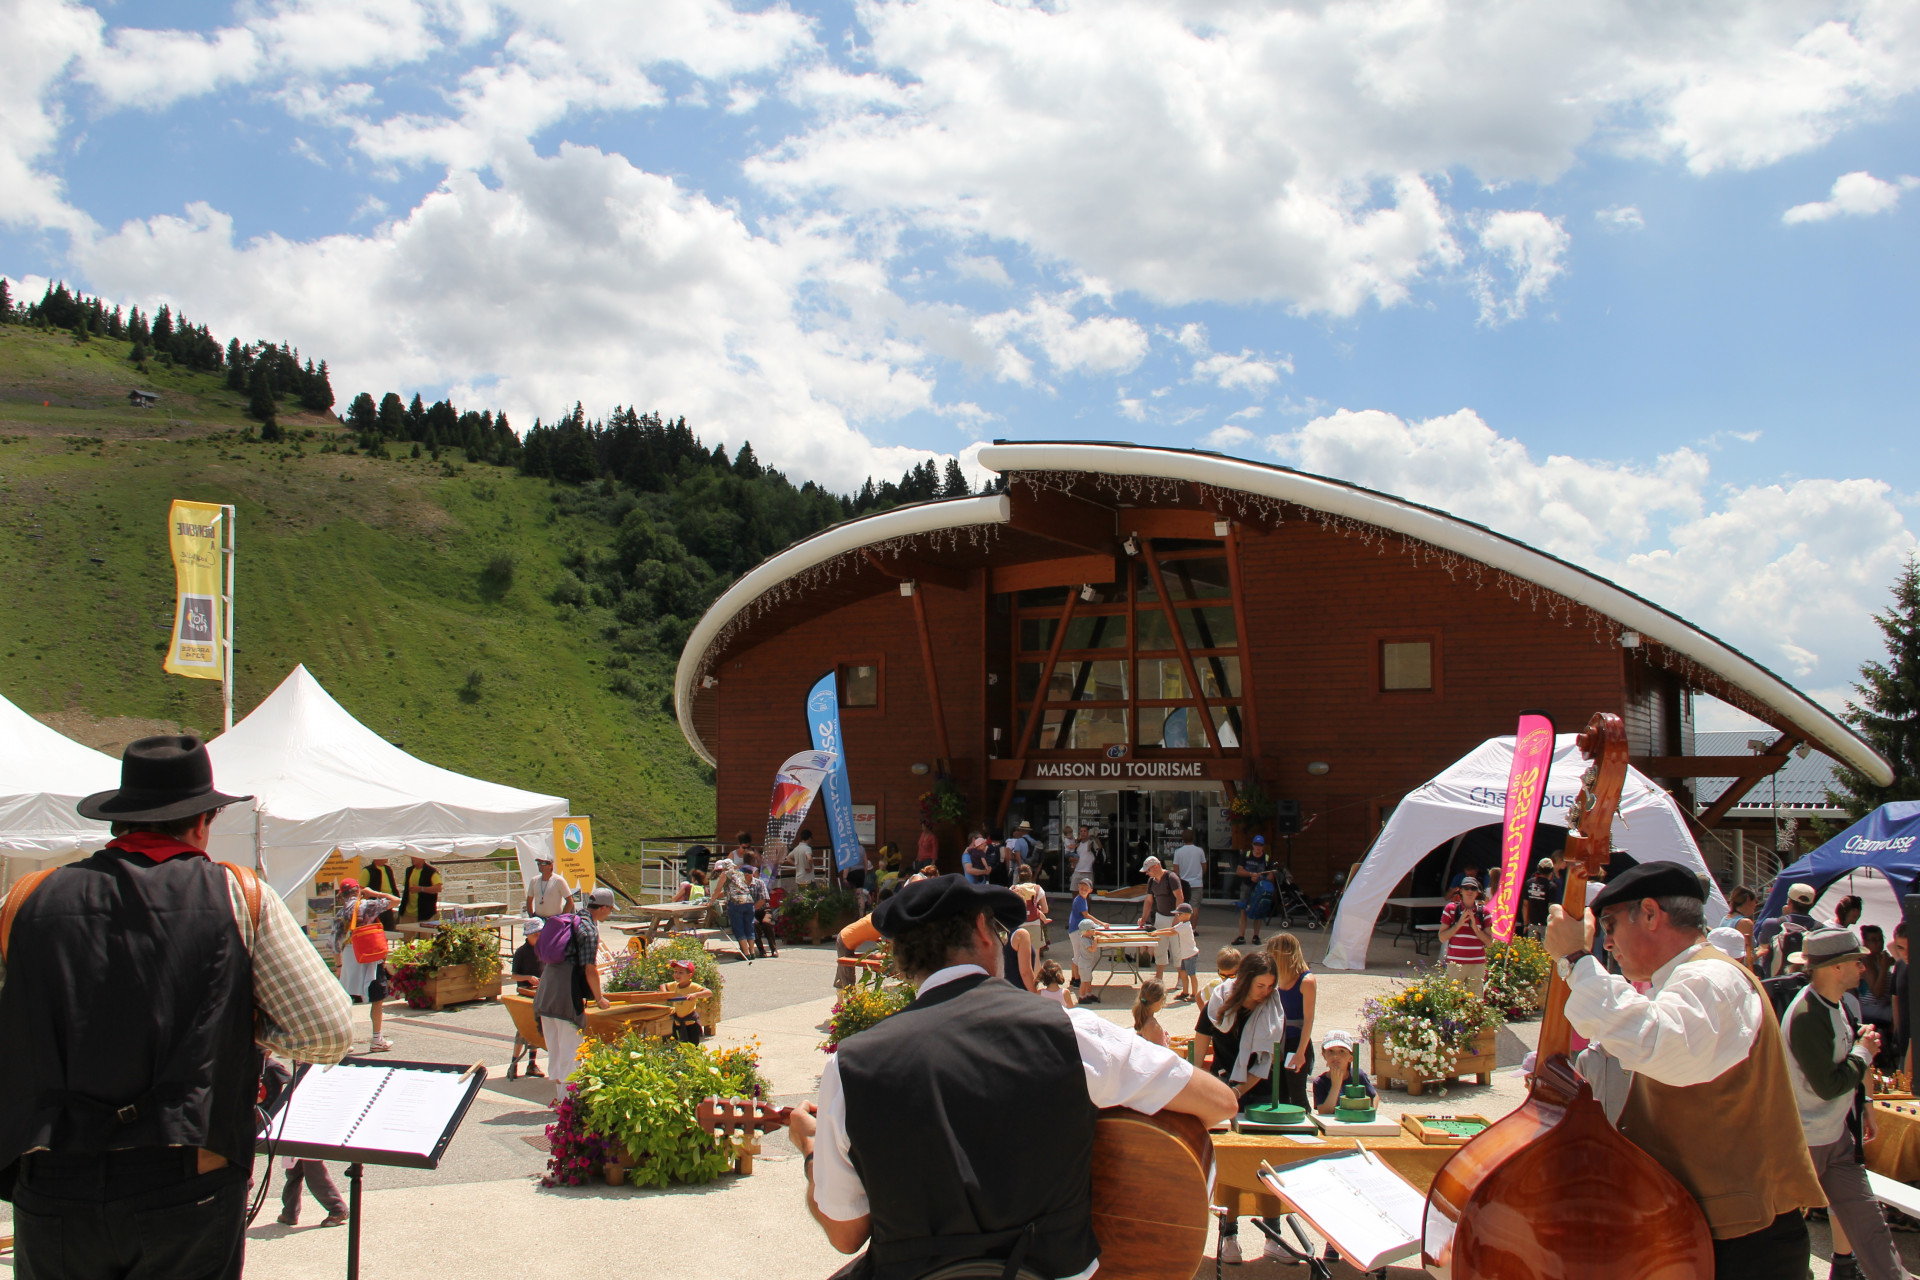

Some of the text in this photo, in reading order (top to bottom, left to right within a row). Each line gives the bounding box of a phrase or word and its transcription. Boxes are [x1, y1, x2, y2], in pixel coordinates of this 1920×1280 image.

[1036, 763, 1202, 777] MAISON DU TOURISME
[1168, 813, 1184, 821] Office
[1845, 834, 1917, 852] Chamrousse
